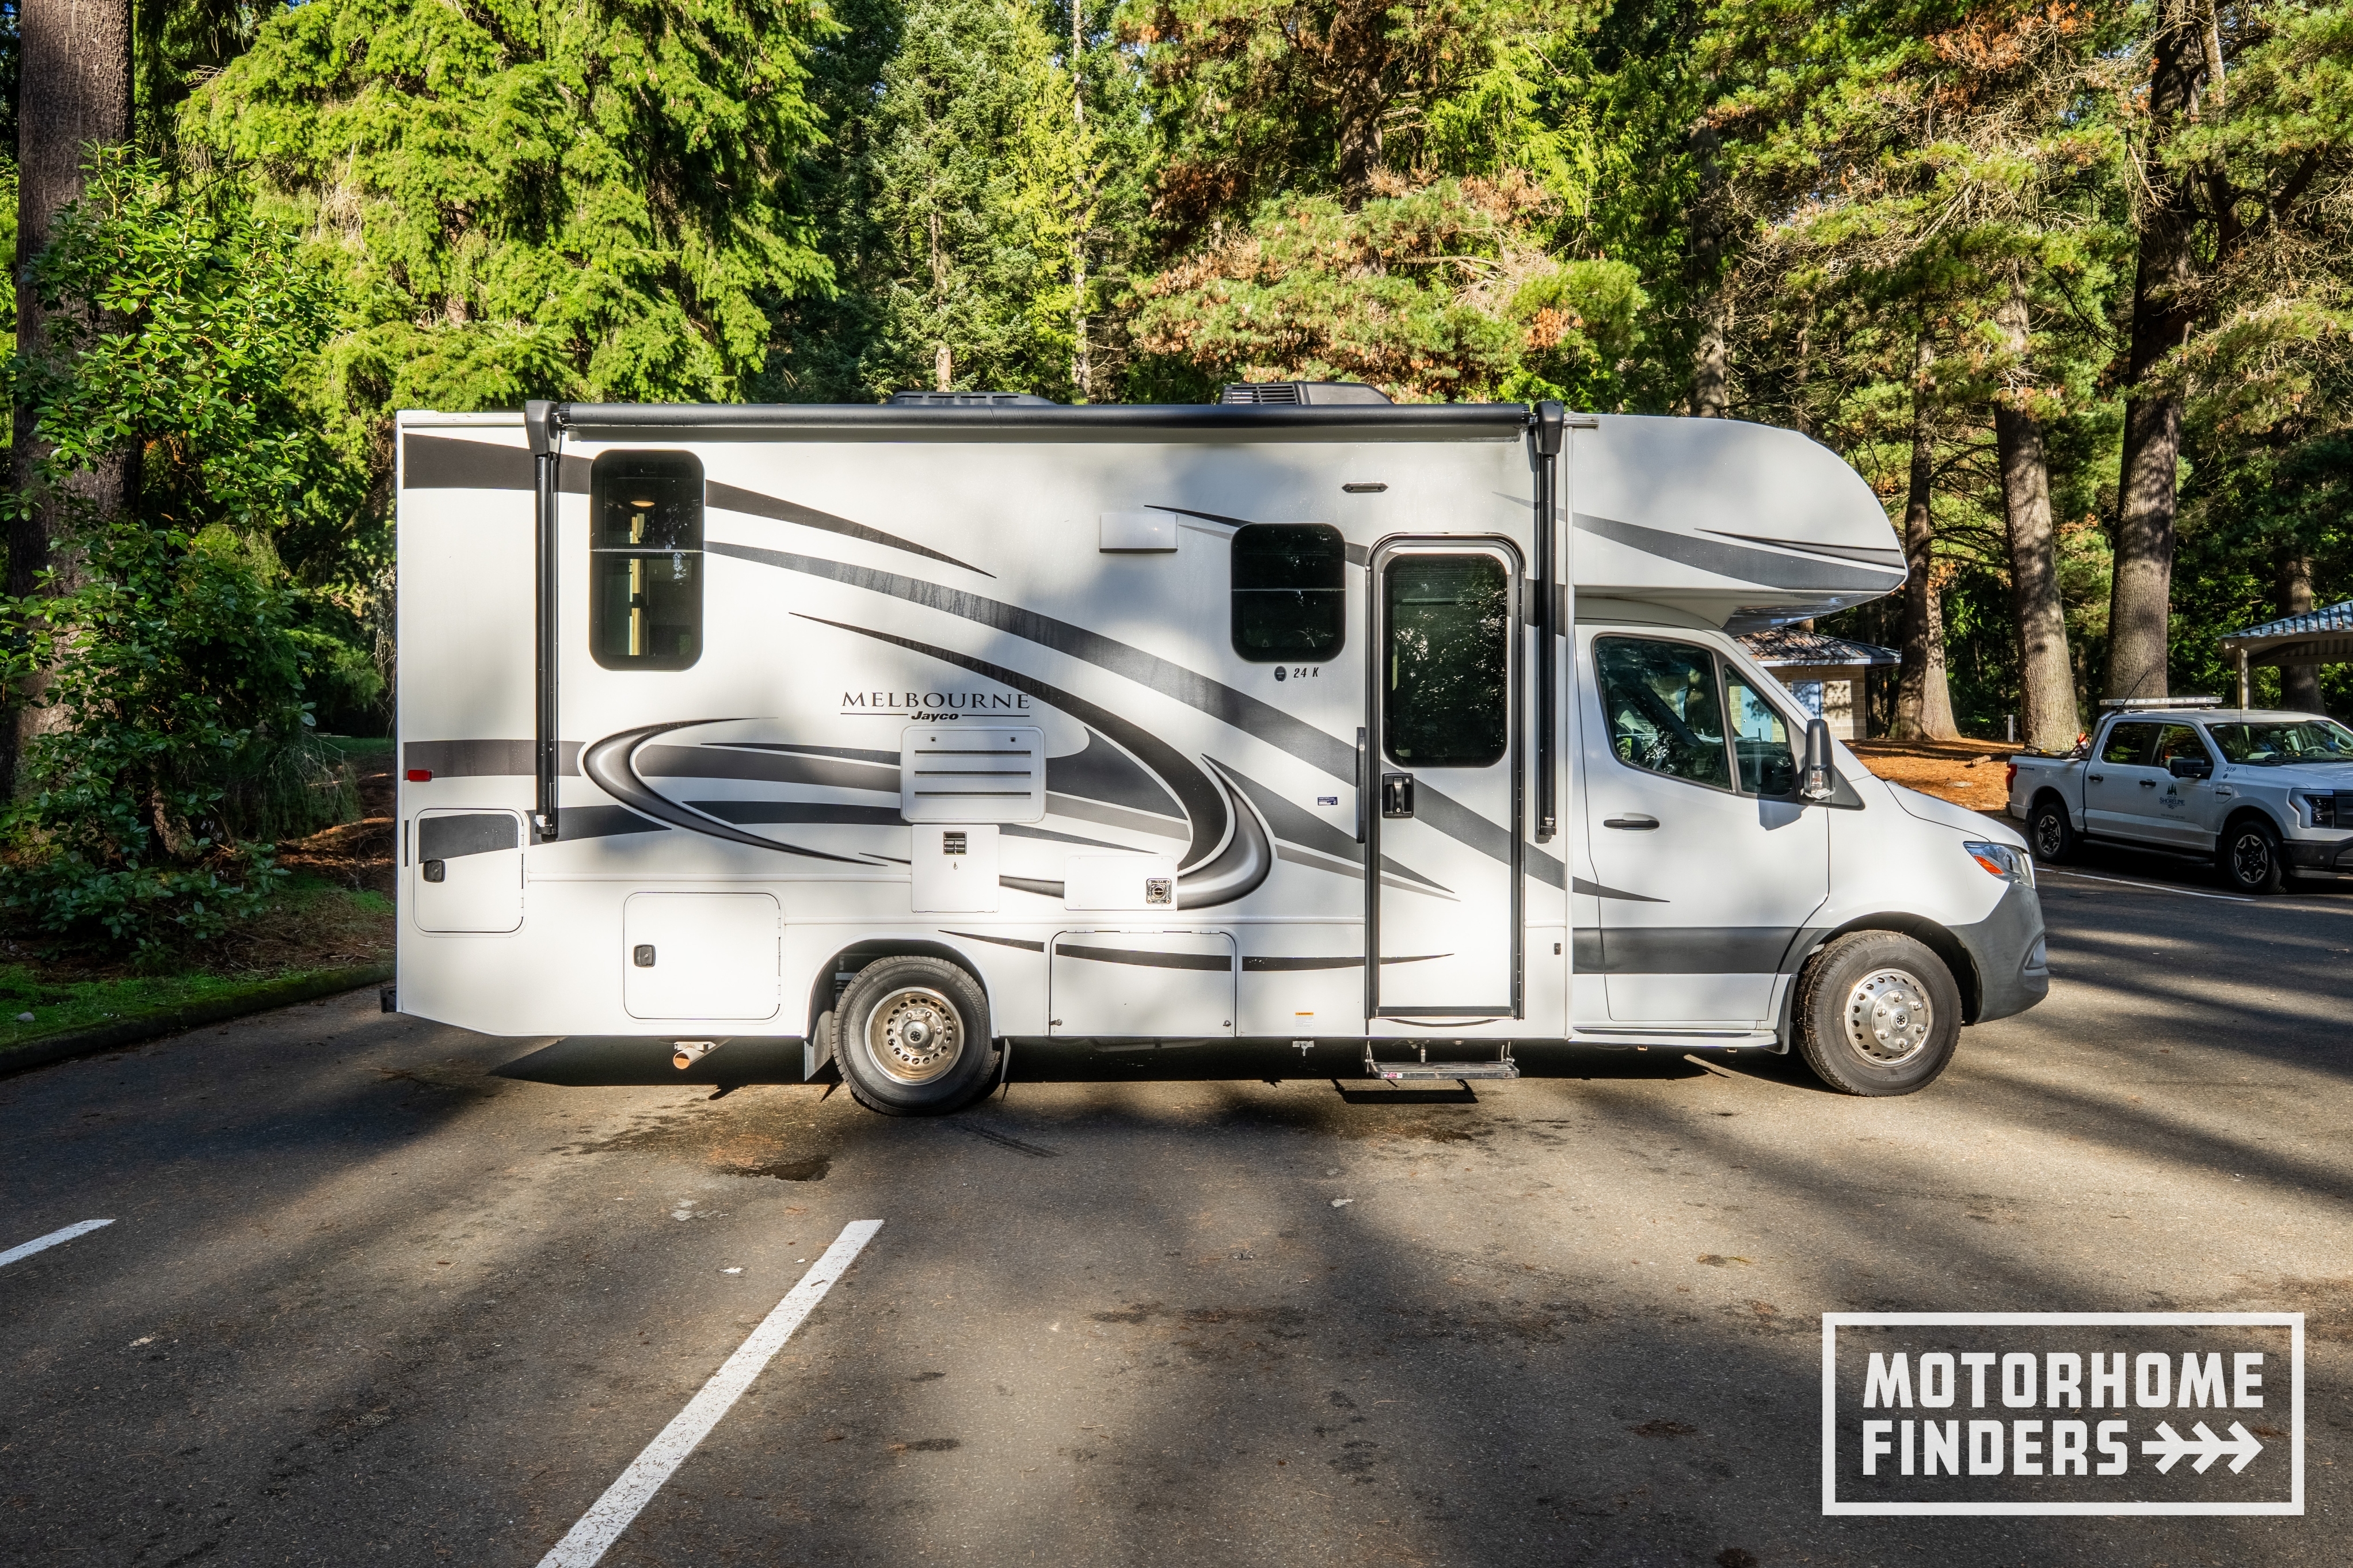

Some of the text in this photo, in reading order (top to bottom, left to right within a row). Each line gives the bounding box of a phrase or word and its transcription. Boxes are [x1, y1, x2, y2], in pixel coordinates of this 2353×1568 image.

[1293, 667, 1319, 678] 24 K
[842, 691, 1030, 709] MELBOURNE
[911, 711, 959, 722] Jayco
[2159, 797, 2185, 805] SHORELINE
[1871, 946, 1901, 956] Continental
